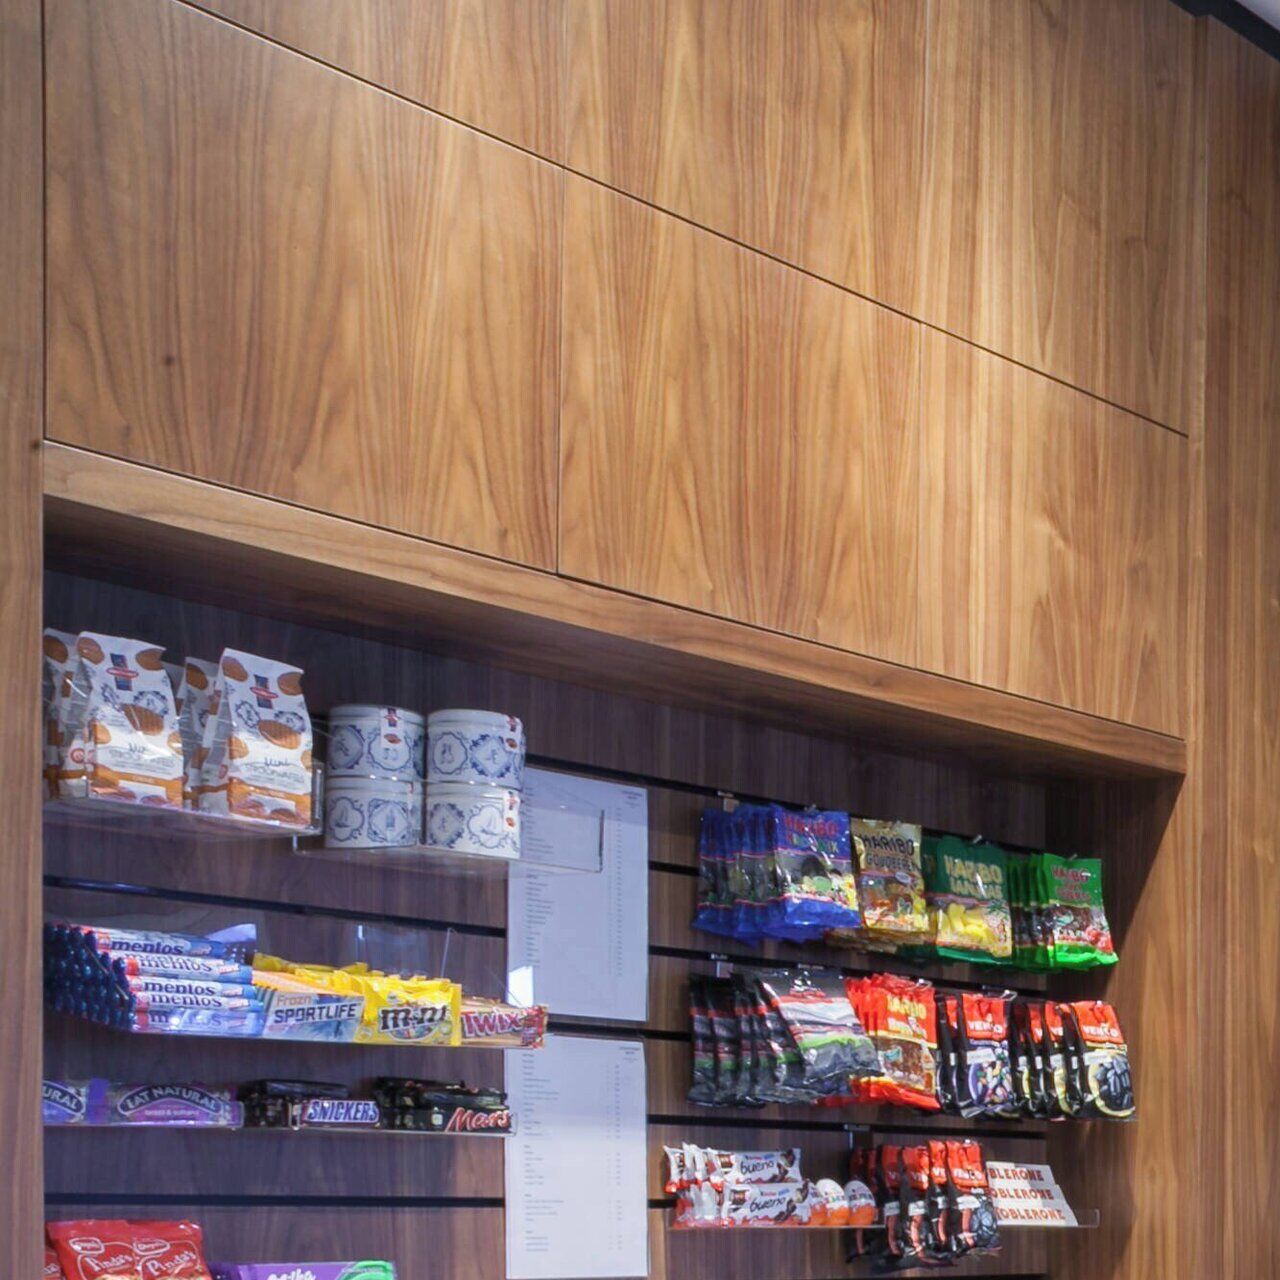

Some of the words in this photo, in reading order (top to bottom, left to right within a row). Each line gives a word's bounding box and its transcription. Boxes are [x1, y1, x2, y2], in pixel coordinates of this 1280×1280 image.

[863, 834, 914, 856] HARIBO
[112, 940, 184, 955] mentos
[144, 981, 216, 996] mentos
[152, 993, 222, 1008] mentos
[274, 1003, 358, 1024] SPORTLIFE
[461, 1007, 521, 1037] Twix
[43, 1085, 78, 1109] URAL
[152, 1086, 218, 1110] NATURAL
[308, 1101, 378, 1121] SNICKERS
[448, 1108, 511, 1132] Mars
[740, 1160, 774, 1174] bueno
[988, 1167, 1044, 1181] BLERONE
[990, 1187, 1054, 1200] OBLERONE
[750, 1197, 786, 1212] bueno
[85, 1253, 133, 1272] Pinda's
[146, 1251, 196, 1276] Pinda's
